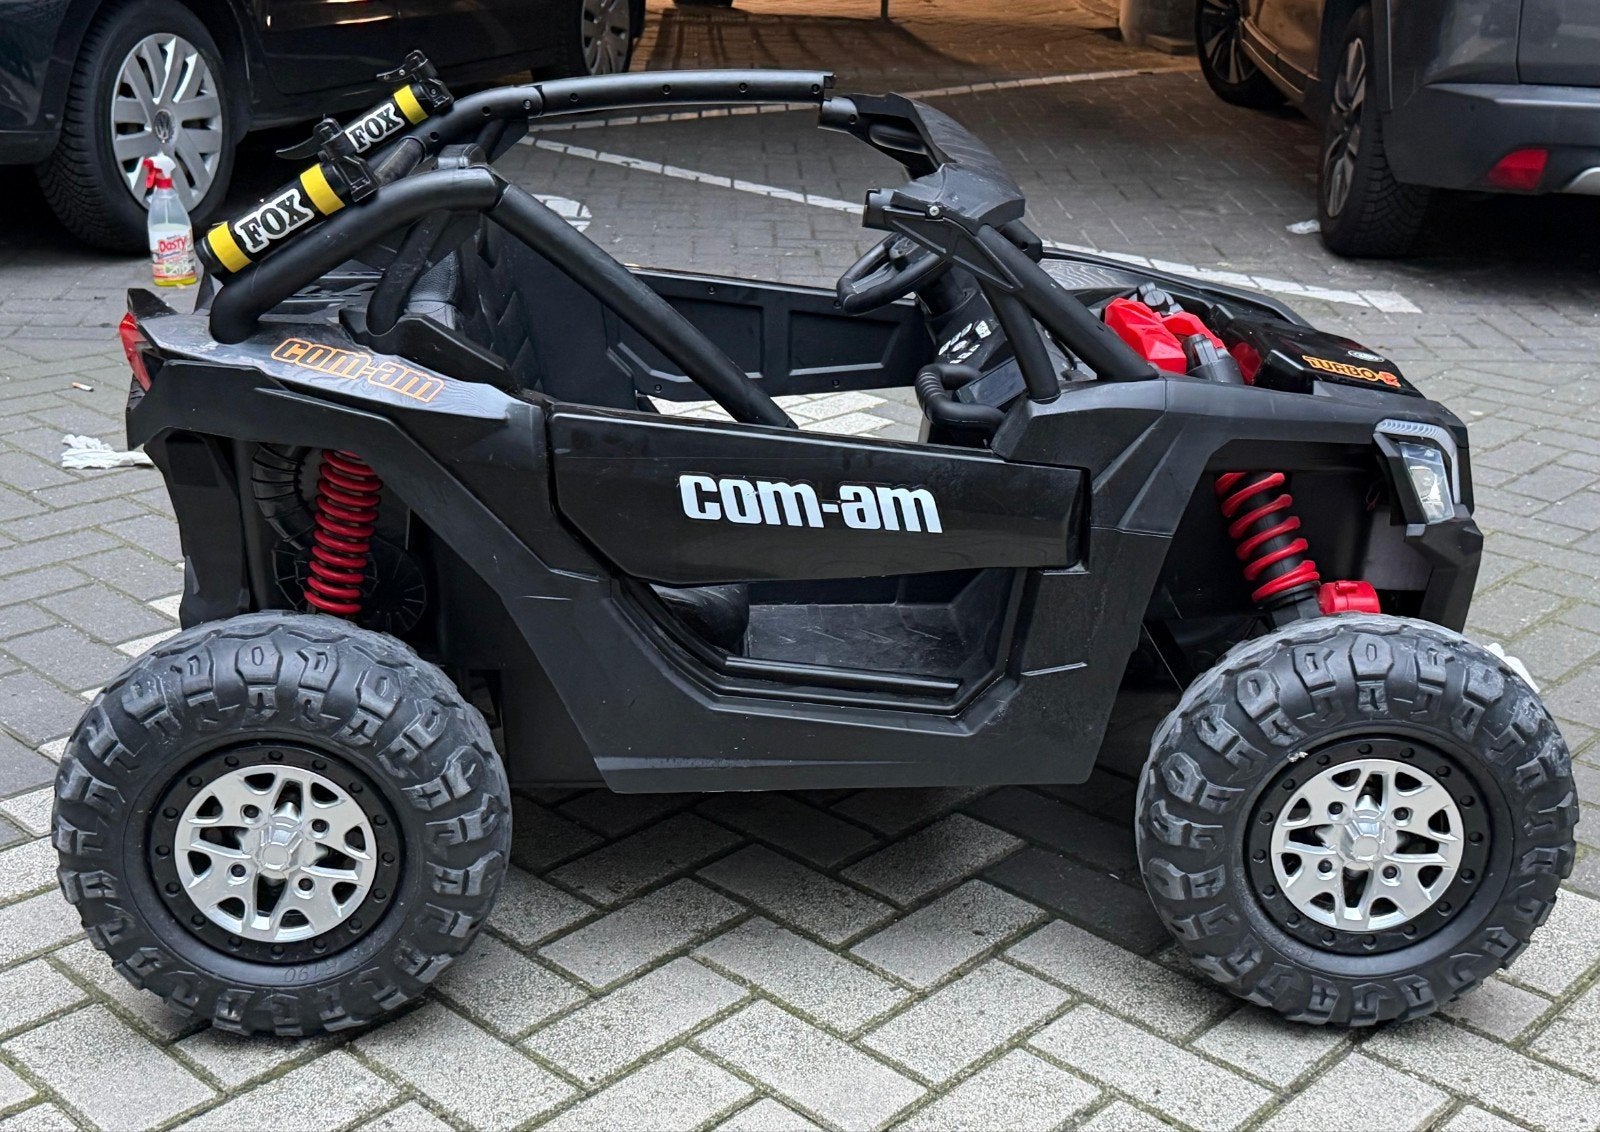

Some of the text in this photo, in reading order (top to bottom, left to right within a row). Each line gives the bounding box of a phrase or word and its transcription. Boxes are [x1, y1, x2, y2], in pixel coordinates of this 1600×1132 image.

[347, 104, 404, 151] FOX
[238, 191, 312, 250] FOX
[270, 337, 446, 403] com-am
[679, 474, 943, 534] com-am
